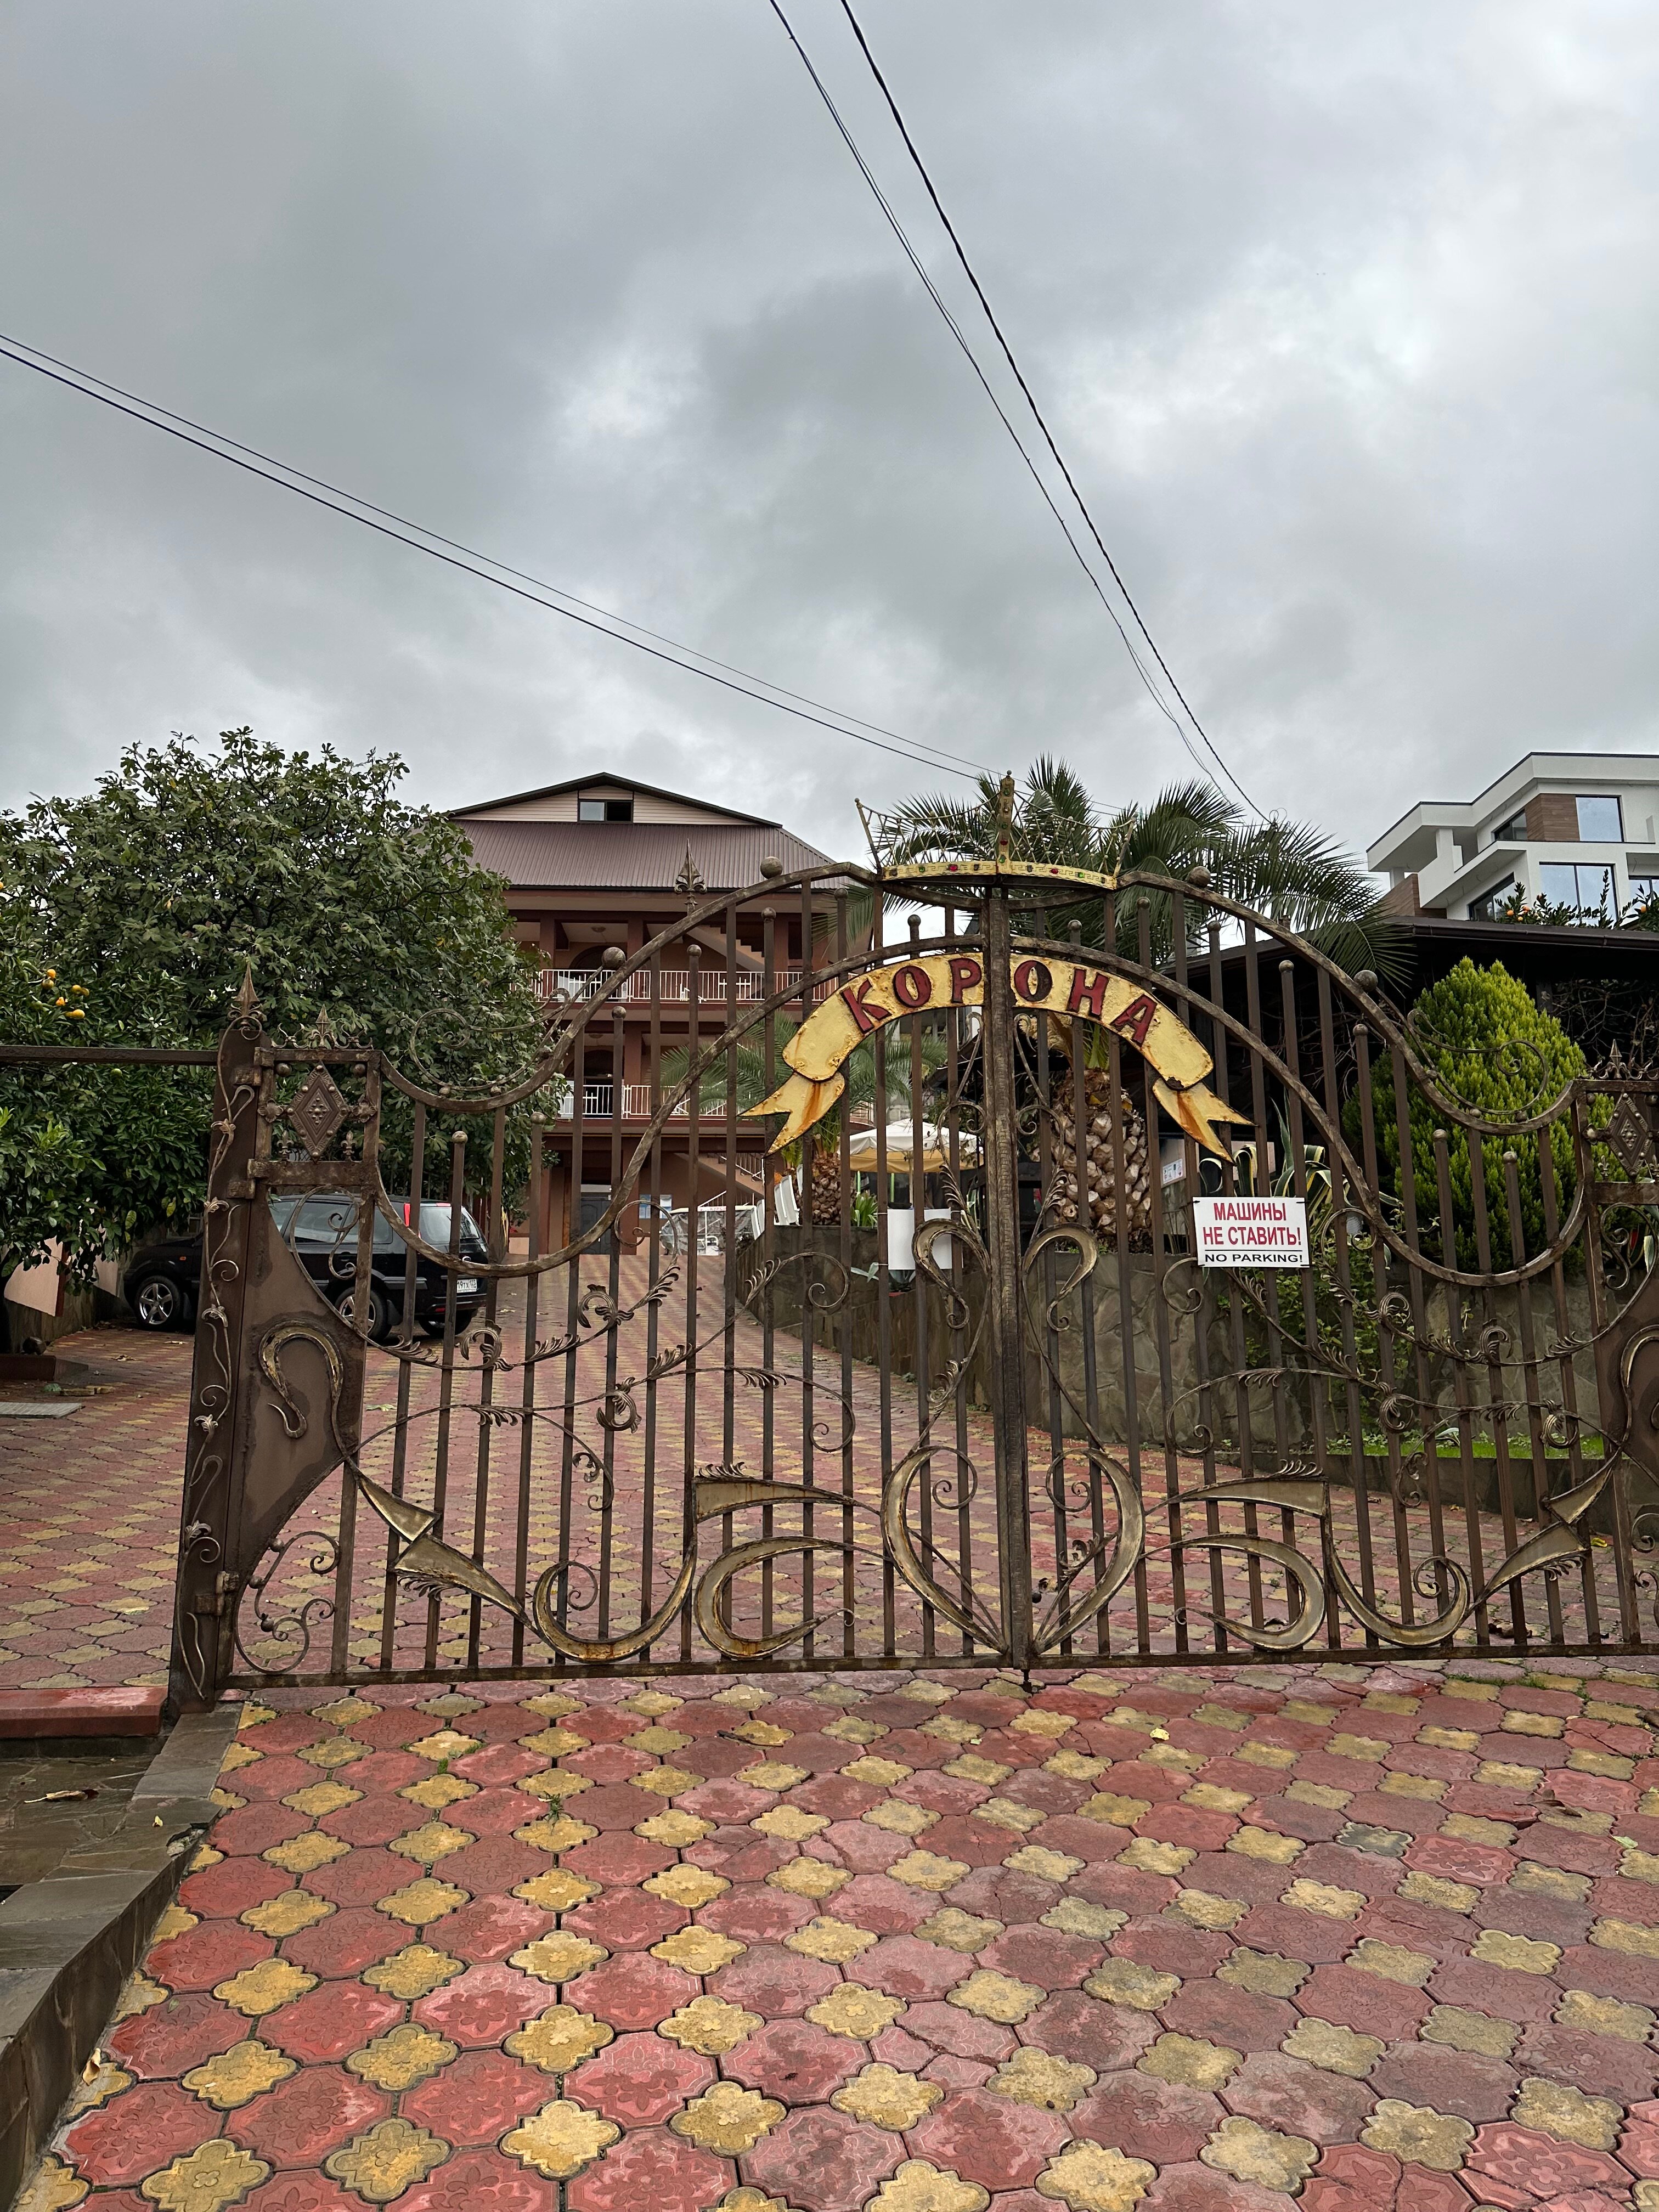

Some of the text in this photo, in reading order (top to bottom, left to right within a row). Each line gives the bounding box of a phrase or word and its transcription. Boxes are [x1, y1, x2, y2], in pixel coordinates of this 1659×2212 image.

[839, 957, 1158, 1047] КОРОНА
[1214, 1203, 1286, 1221] МАШИНЫ
[1203, 1227, 1301, 1245] НЕ СТАВИТЬ!
[1233, 1254, 1302, 1262] PARKING!
